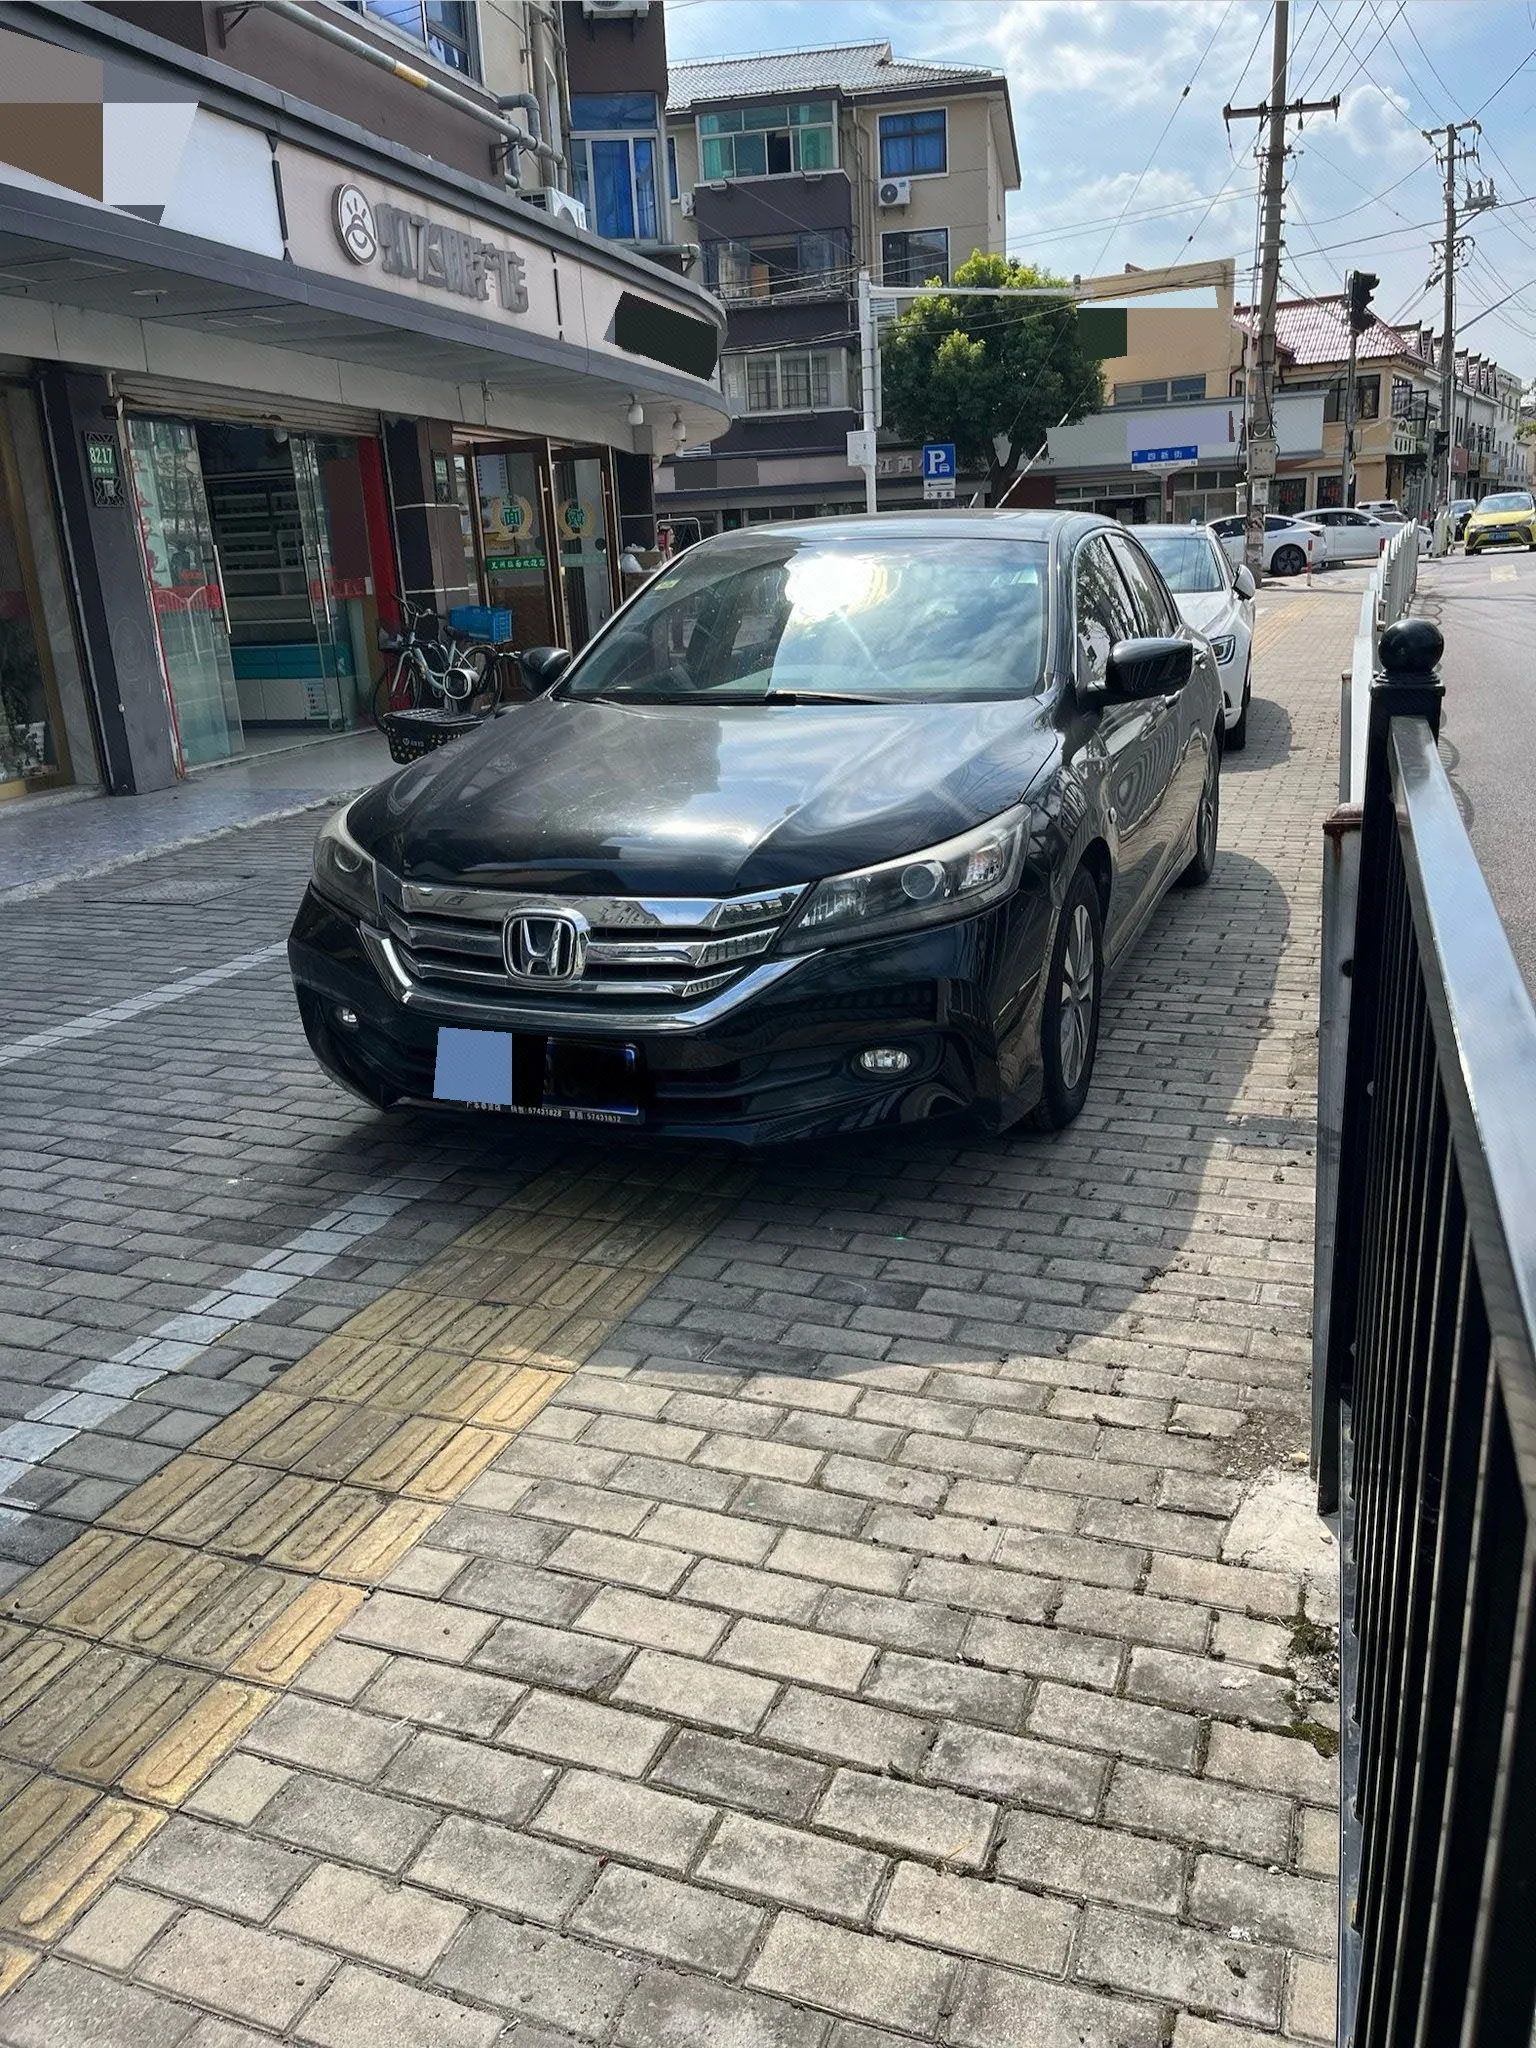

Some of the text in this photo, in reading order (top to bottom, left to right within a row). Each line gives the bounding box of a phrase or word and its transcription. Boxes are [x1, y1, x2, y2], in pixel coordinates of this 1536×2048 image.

[89, 447, 112, 464] 8217
[877, 455, 923, 473] 江西
[928, 450, 946, 474] P
[503, 506, 521, 527] 面
